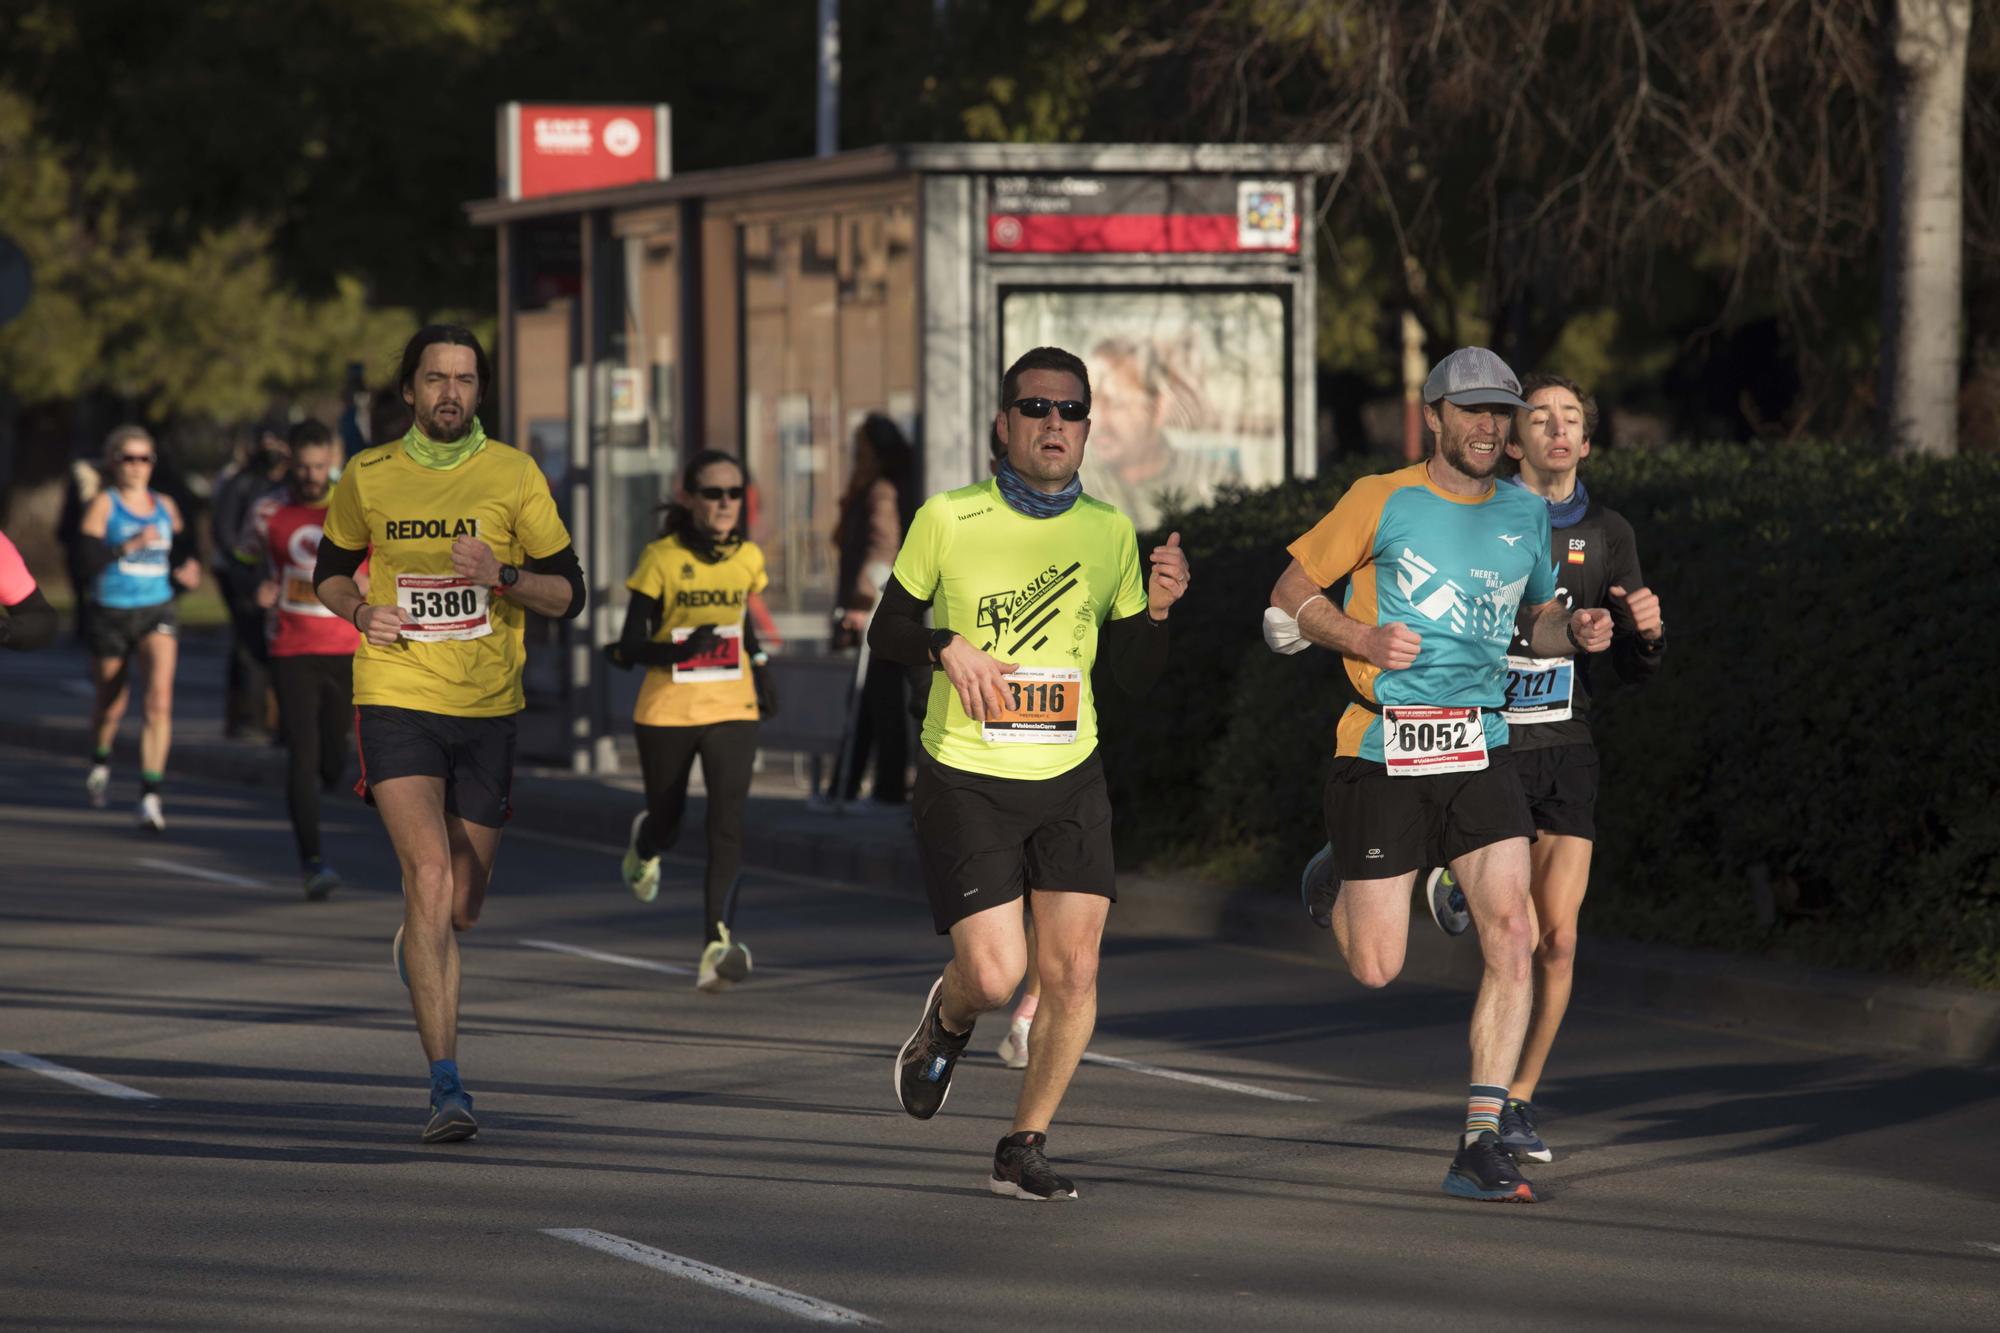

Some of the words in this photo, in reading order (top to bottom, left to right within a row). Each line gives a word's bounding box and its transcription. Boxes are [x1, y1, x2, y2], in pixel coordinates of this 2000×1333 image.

[1568, 538, 1586, 551] ESP
[1470, 568, 1499, 580] THERE'S
[1486, 580, 1504, 589] ONLY
[411, 589, 477, 618] 5380
[1504, 668, 1557, 697] 2127
[1399, 722, 1469, 752] 6052
